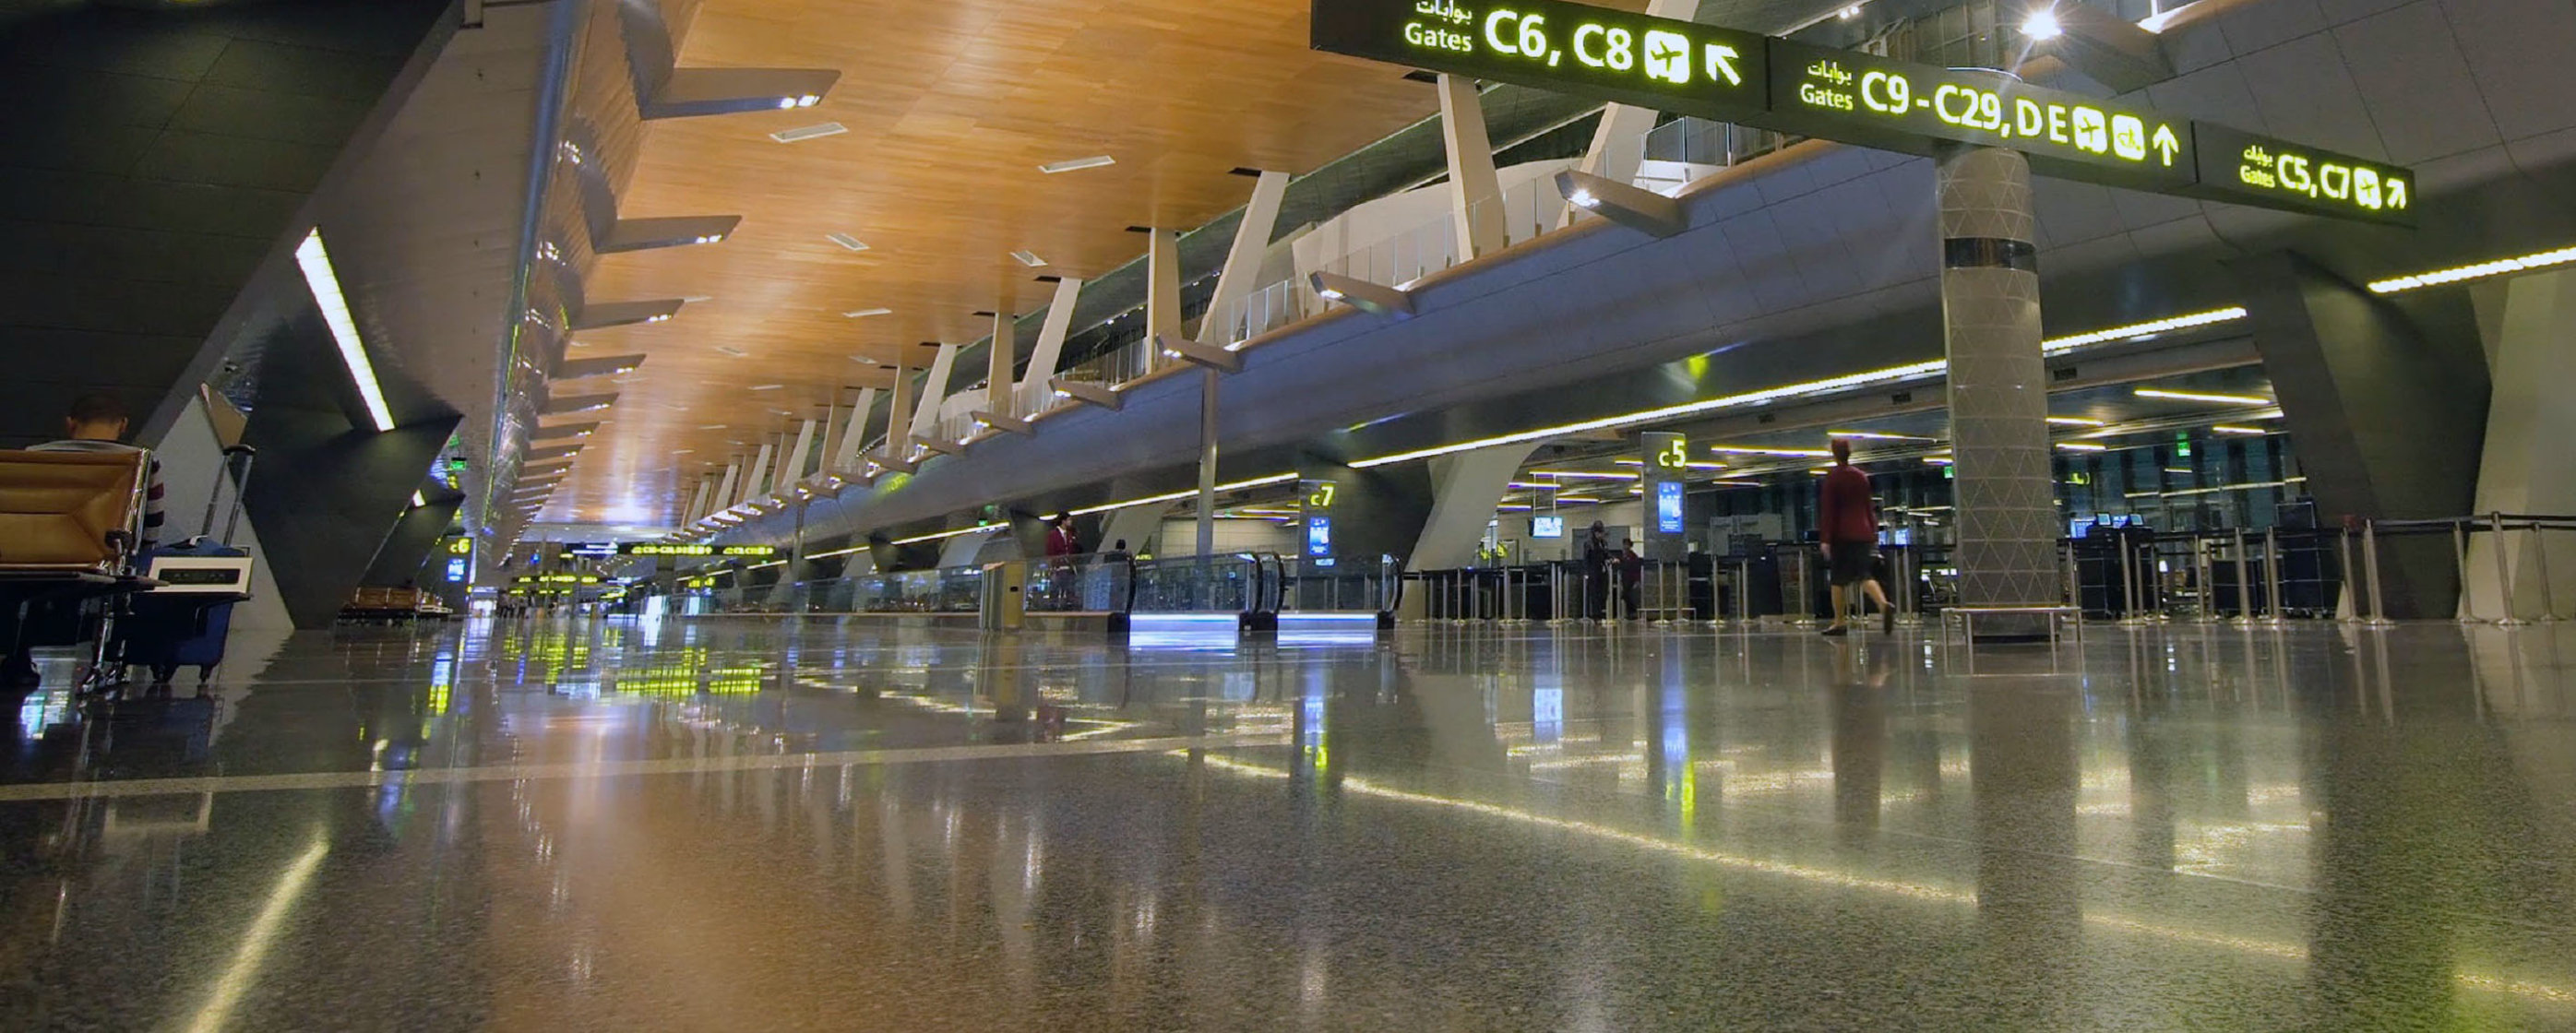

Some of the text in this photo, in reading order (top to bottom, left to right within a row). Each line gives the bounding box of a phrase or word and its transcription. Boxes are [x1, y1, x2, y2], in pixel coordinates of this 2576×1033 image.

[1404, 22, 1473, 52] Gates
[1485, 9, 1633, 71] C6, C8
[1807, 60, 1853, 85] بوابات
[1800, 83, 1854, 110] Gates
[2016, 98, 2044, 137] D
[2047, 104, 2069, 143] E
[2239, 164, 2275, 188] Gates
[2277, 154, 2350, 199] C5, C7
